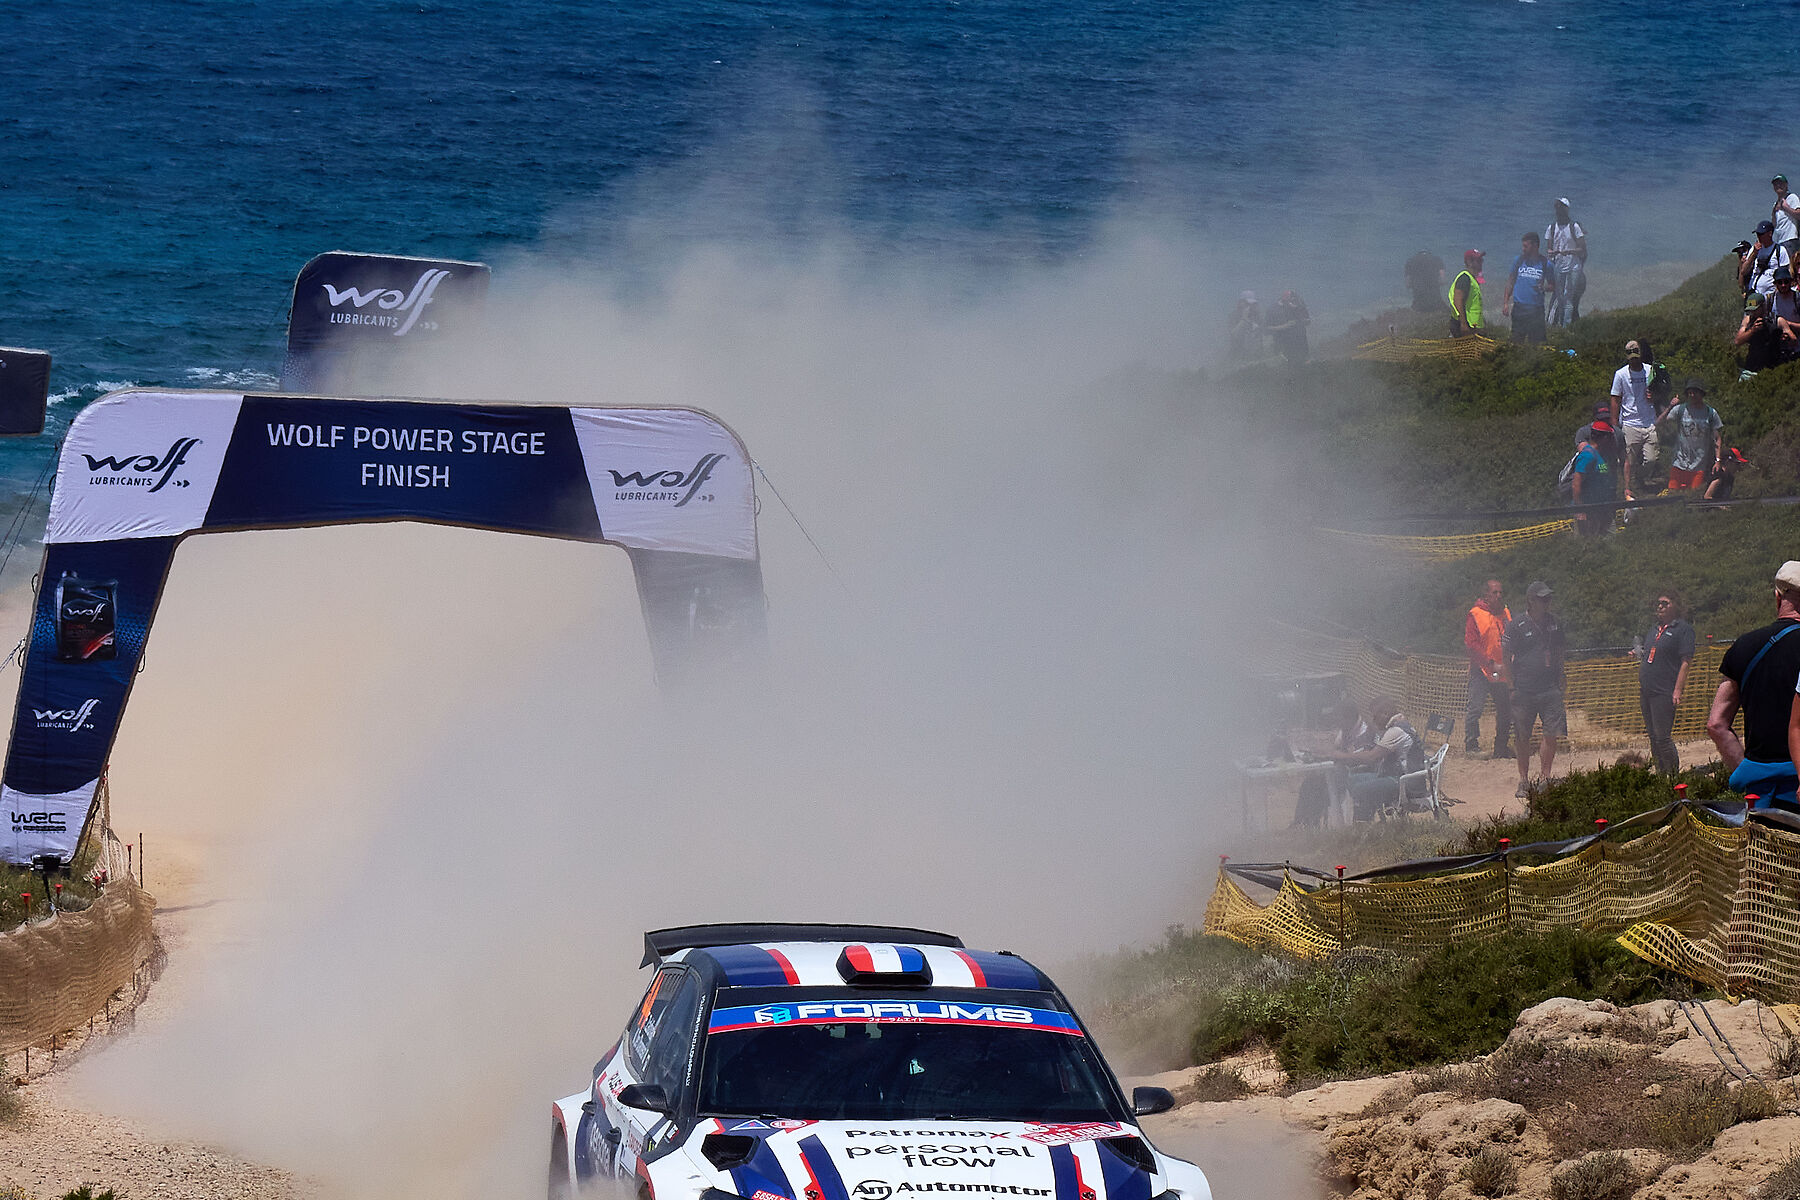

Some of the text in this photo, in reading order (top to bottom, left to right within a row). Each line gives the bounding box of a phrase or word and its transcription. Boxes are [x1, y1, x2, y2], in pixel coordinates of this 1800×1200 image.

[330, 312, 399, 329] LUBRICANTS
[267, 423, 546, 455] WOLF POWER STAGE
[89, 476, 153, 486] LUBRICANTS
[361, 463, 450, 488] FINISH
[615, 491, 679, 501] LUBRICANTS
[11, 811, 66, 824] WRC
[797, 1003, 1034, 1025] FORUM8
[845, 1129, 1011, 1140] petromax
[845, 1144, 1036, 1159] personal
[902, 1154, 996, 1168] flow
[896, 1182, 1053, 1197] Automotor
